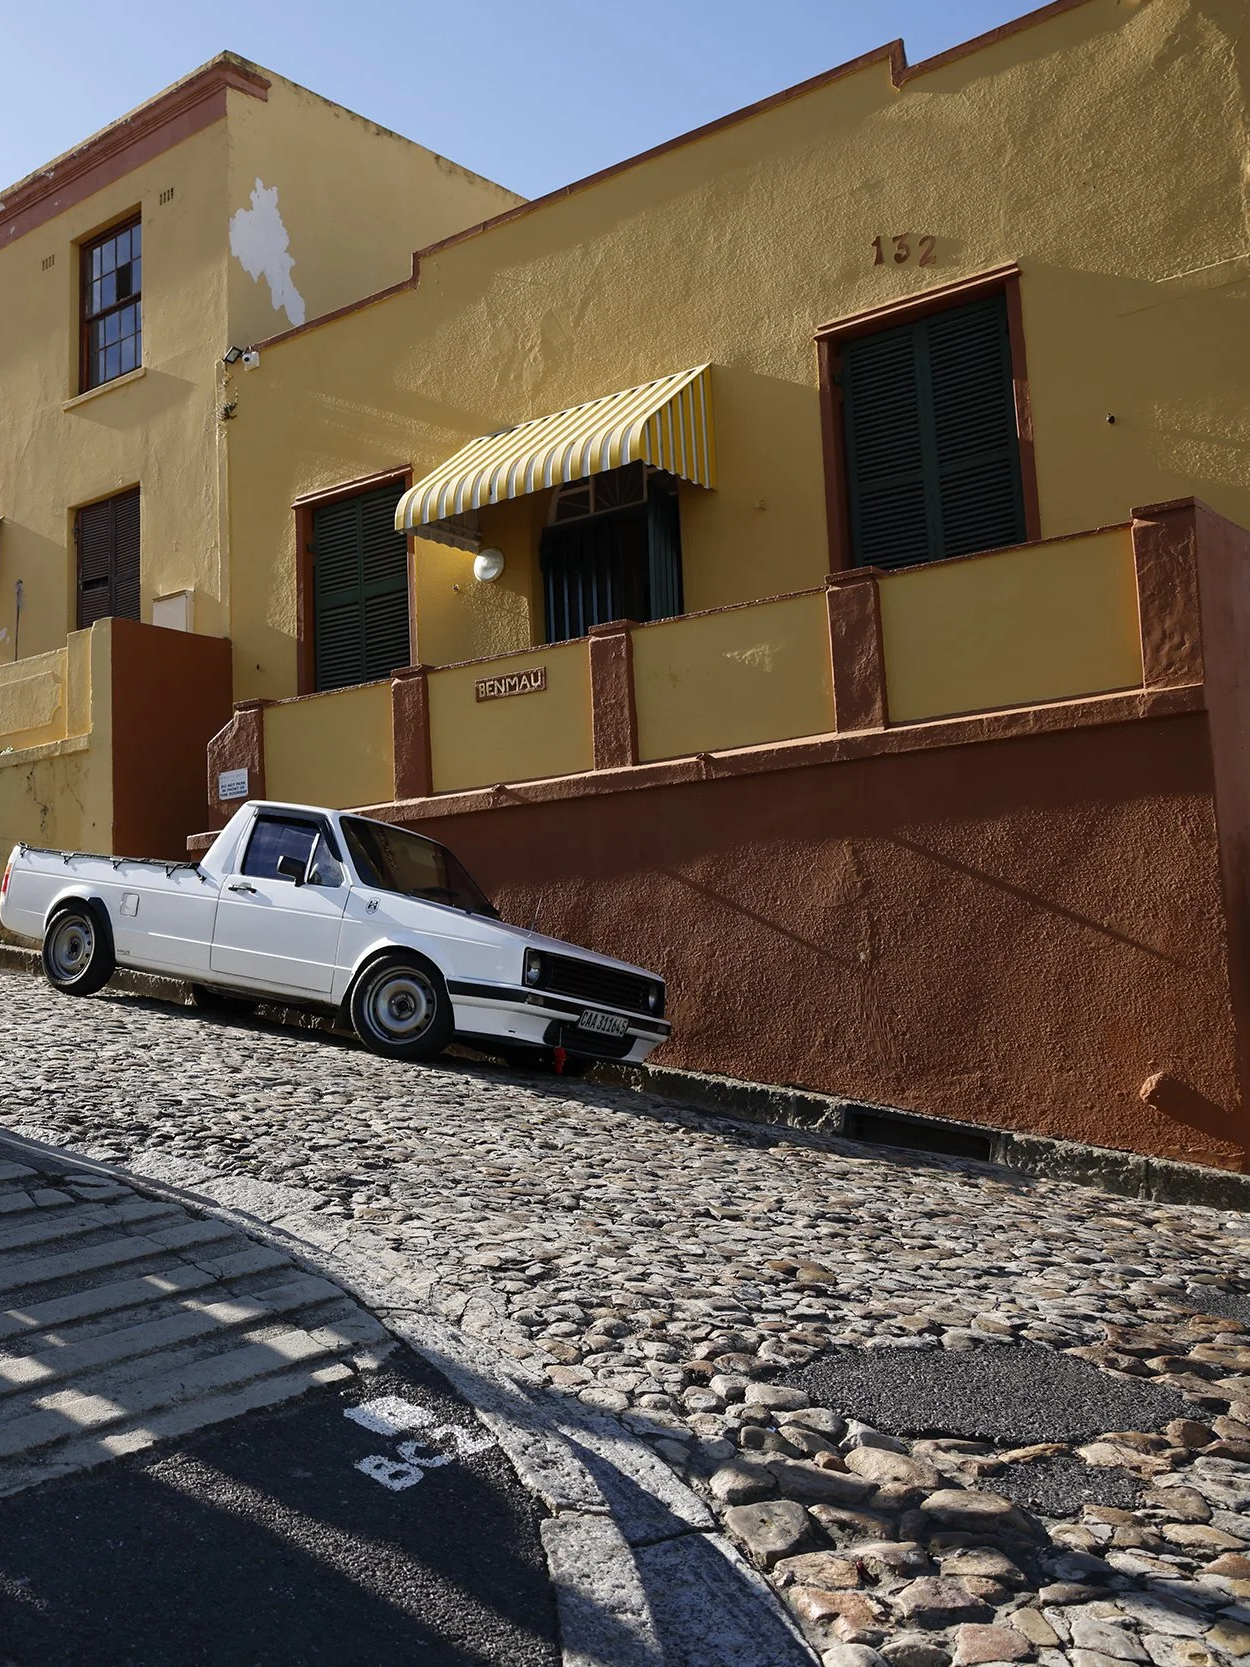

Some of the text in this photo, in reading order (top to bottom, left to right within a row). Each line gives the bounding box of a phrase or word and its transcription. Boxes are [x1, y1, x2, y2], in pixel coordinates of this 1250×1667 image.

[871, 232, 937, 268] 132
[478, 669, 542, 698] BENMAU
[580, 1011, 598, 1029] CAA
